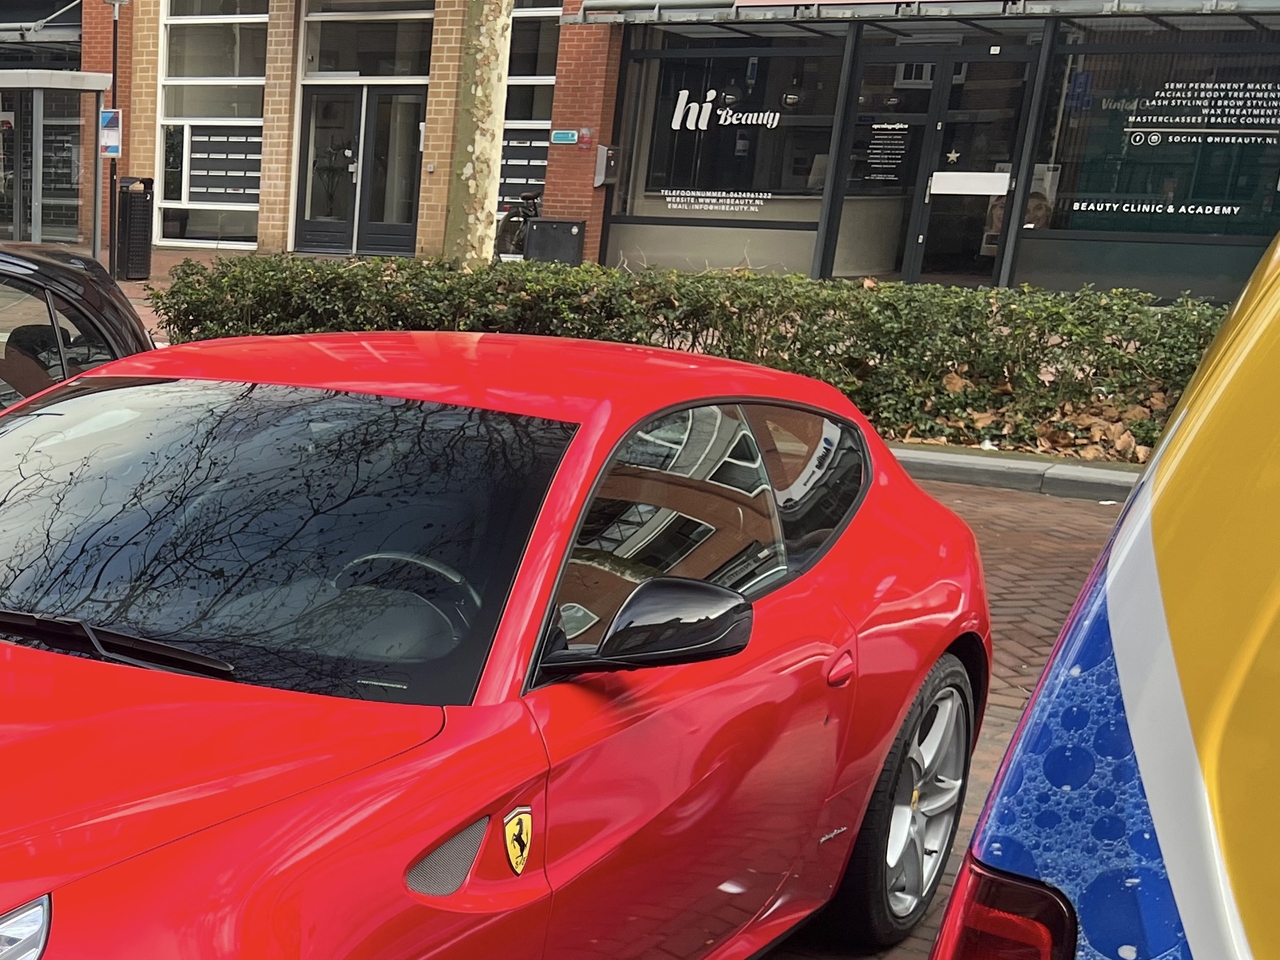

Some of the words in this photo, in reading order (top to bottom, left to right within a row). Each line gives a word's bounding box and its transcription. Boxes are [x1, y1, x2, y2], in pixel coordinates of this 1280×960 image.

[1164, 82, 1187, 90] SEMI
[1189, 82, 1245, 90] PERMANENT
[1171, 99, 1209, 107] STYLING
[671, 89, 717, 131] hi
[716, 107, 780, 129] Beauty
[1128, 115, 1202, 124] MASTERCLASSES
[1210, 116, 1238, 124] BASIC
[1168, 135, 1203, 143] SOCIAL
[1207, 136, 1278, 145] @HIBEAUTY.NL
[1073, 202, 1120, 212] BEAUTY
[1122, 203, 1164, 213] CLINIC
[1166, 204, 1175, 214] &
[1178, 205, 1241, 215] ACADEMY
